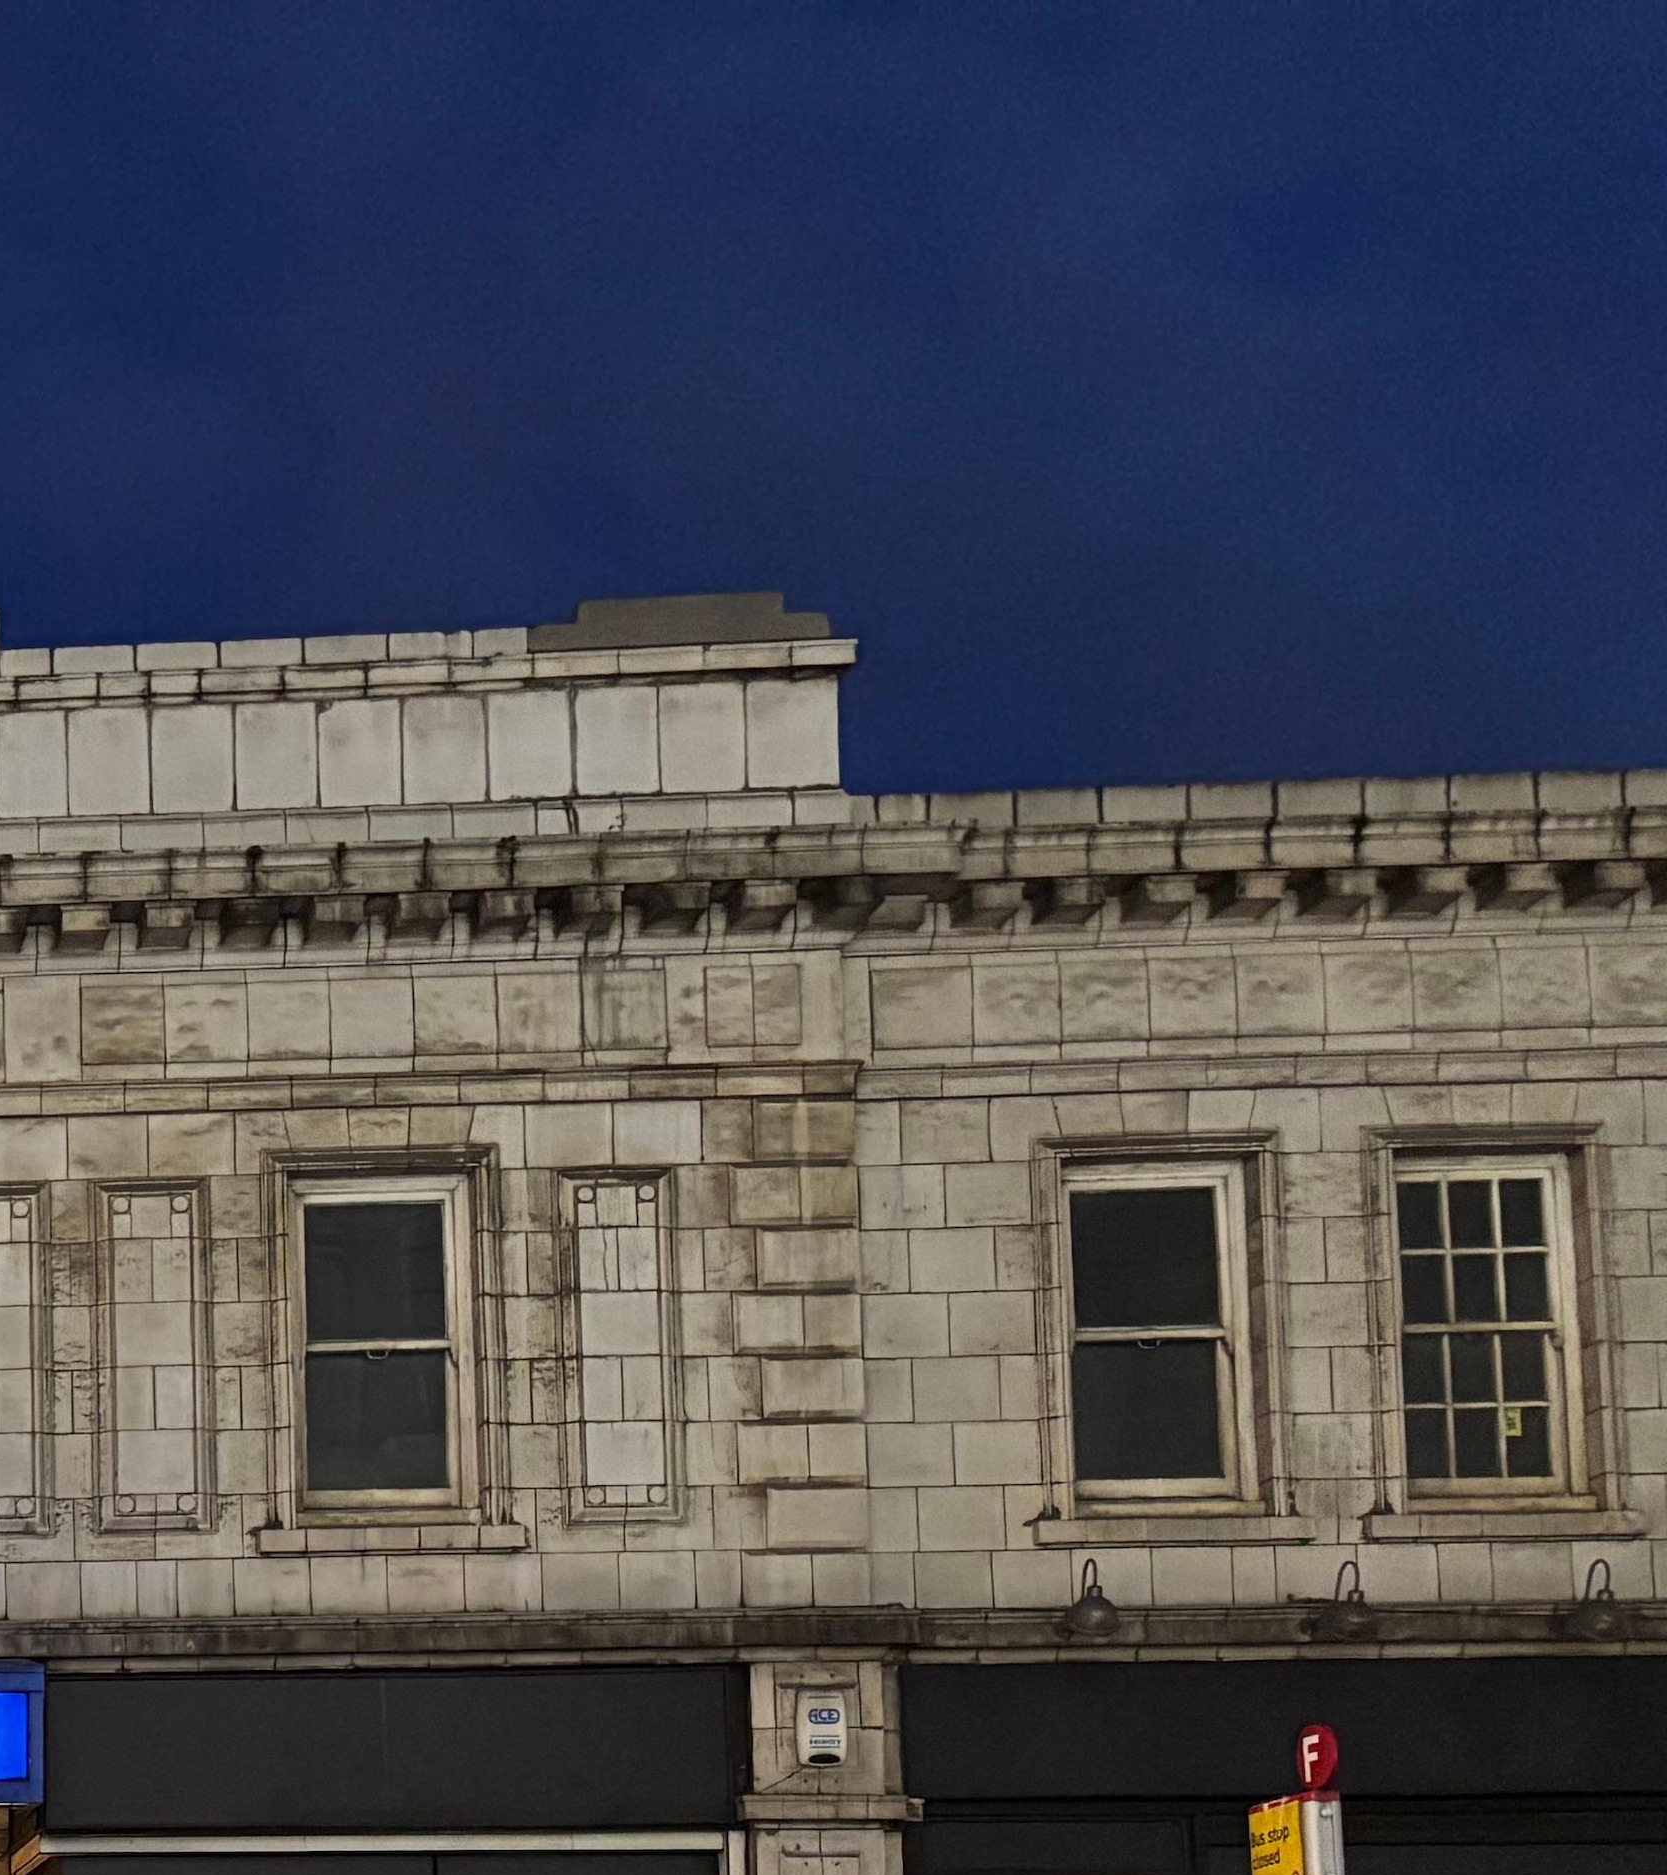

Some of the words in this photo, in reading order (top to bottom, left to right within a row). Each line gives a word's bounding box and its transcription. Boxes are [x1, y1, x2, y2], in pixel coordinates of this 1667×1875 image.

[1302, 1734, 1320, 1783] F
[1267, 1825, 1290, 1844] stop
[1253, 1848, 1280, 1870] closed
